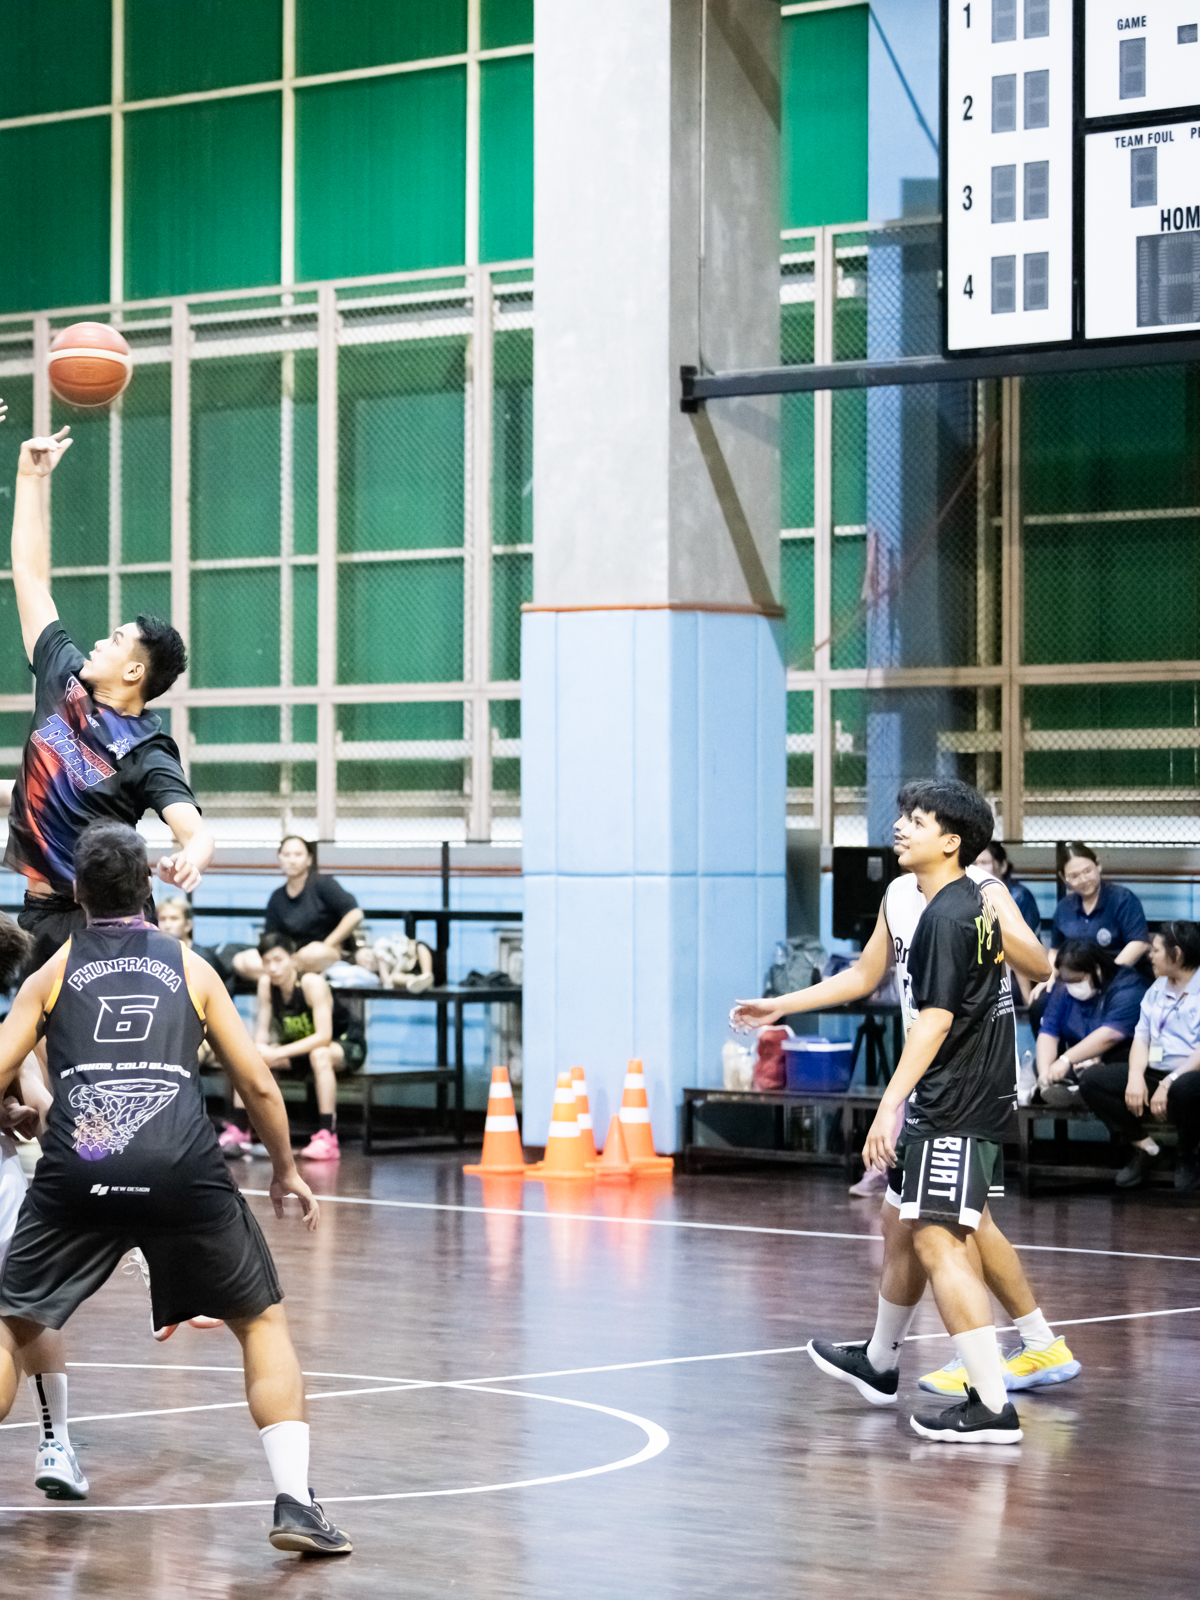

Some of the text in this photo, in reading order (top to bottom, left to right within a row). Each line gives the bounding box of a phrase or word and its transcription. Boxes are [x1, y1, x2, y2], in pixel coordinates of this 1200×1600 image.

[963, 3, 971, 28] 1
[1117, 15, 1147, 30] GAME
[963, 95, 974, 121] 2
[1115, 134, 1143, 148] TEAM
[1148, 130, 1175, 145] FOUL
[963, 185, 973, 211] 3
[963, 274, 974, 300] 4
[36, 713, 106, 787] TIGERS
[67, 956, 182, 993] PHUNPRACHA
[94, 994, 160, 1042] 6
[116, 1061, 148, 1070] COLD
